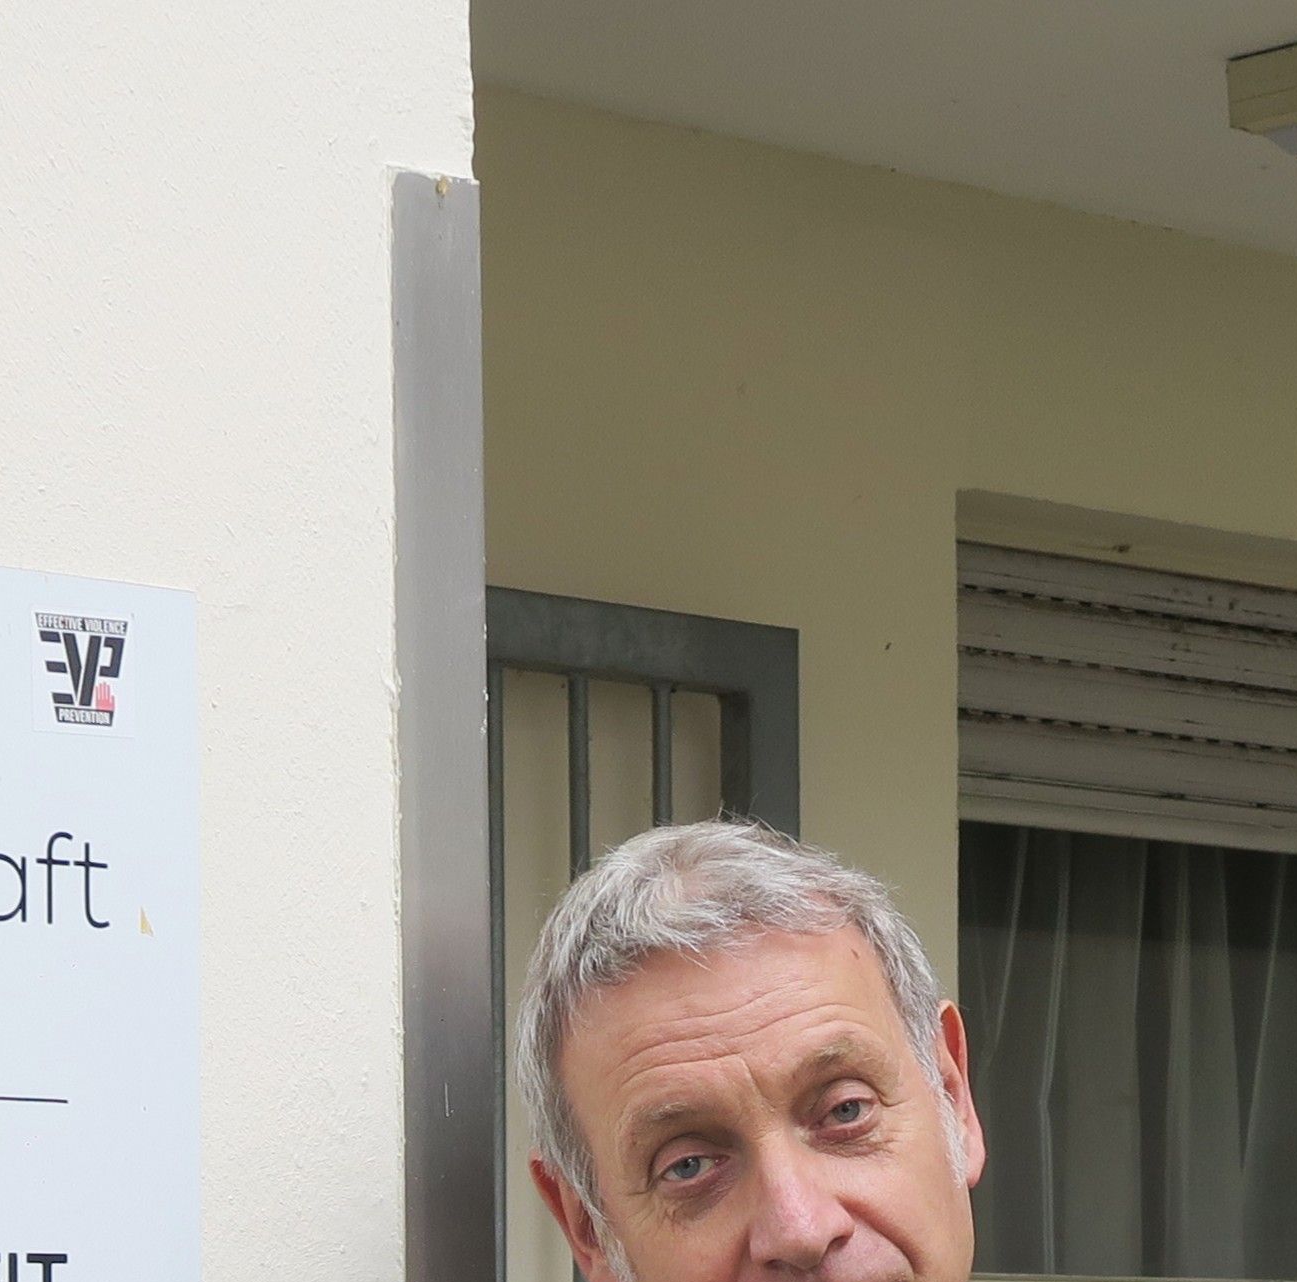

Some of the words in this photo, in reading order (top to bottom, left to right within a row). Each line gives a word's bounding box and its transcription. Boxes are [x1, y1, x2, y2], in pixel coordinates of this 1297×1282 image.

[37, 613, 83, 631] EFFECTIVE
[84, 617, 126, 635] VIOLENCE
[58, 708, 111, 725] PREVENTION
